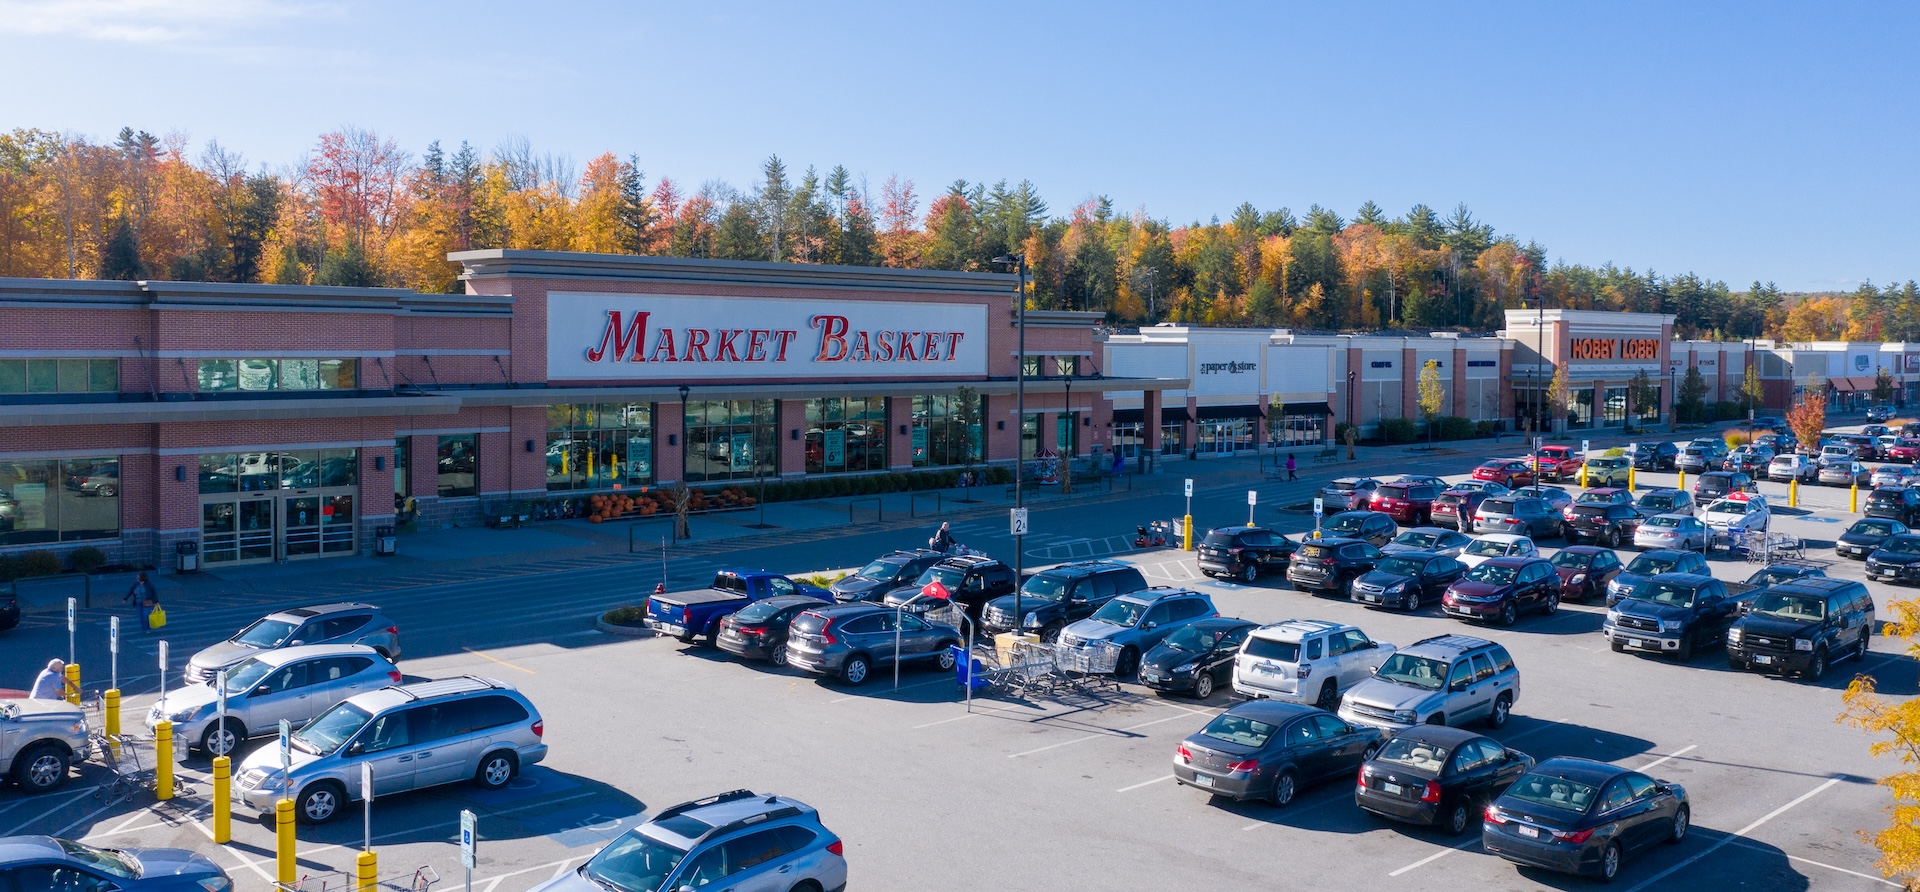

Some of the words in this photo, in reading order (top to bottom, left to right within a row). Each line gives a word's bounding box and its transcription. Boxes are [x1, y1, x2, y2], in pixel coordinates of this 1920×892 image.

[586, 310, 798, 363] MARKET
[811, 313, 964, 363] BASKET
[1570, 338, 1617, 359] HOBBY
[1620, 339, 1661, 359] LOBBY
[1206, 363, 1229, 374] paper
[1237, 361, 1257, 371] store
